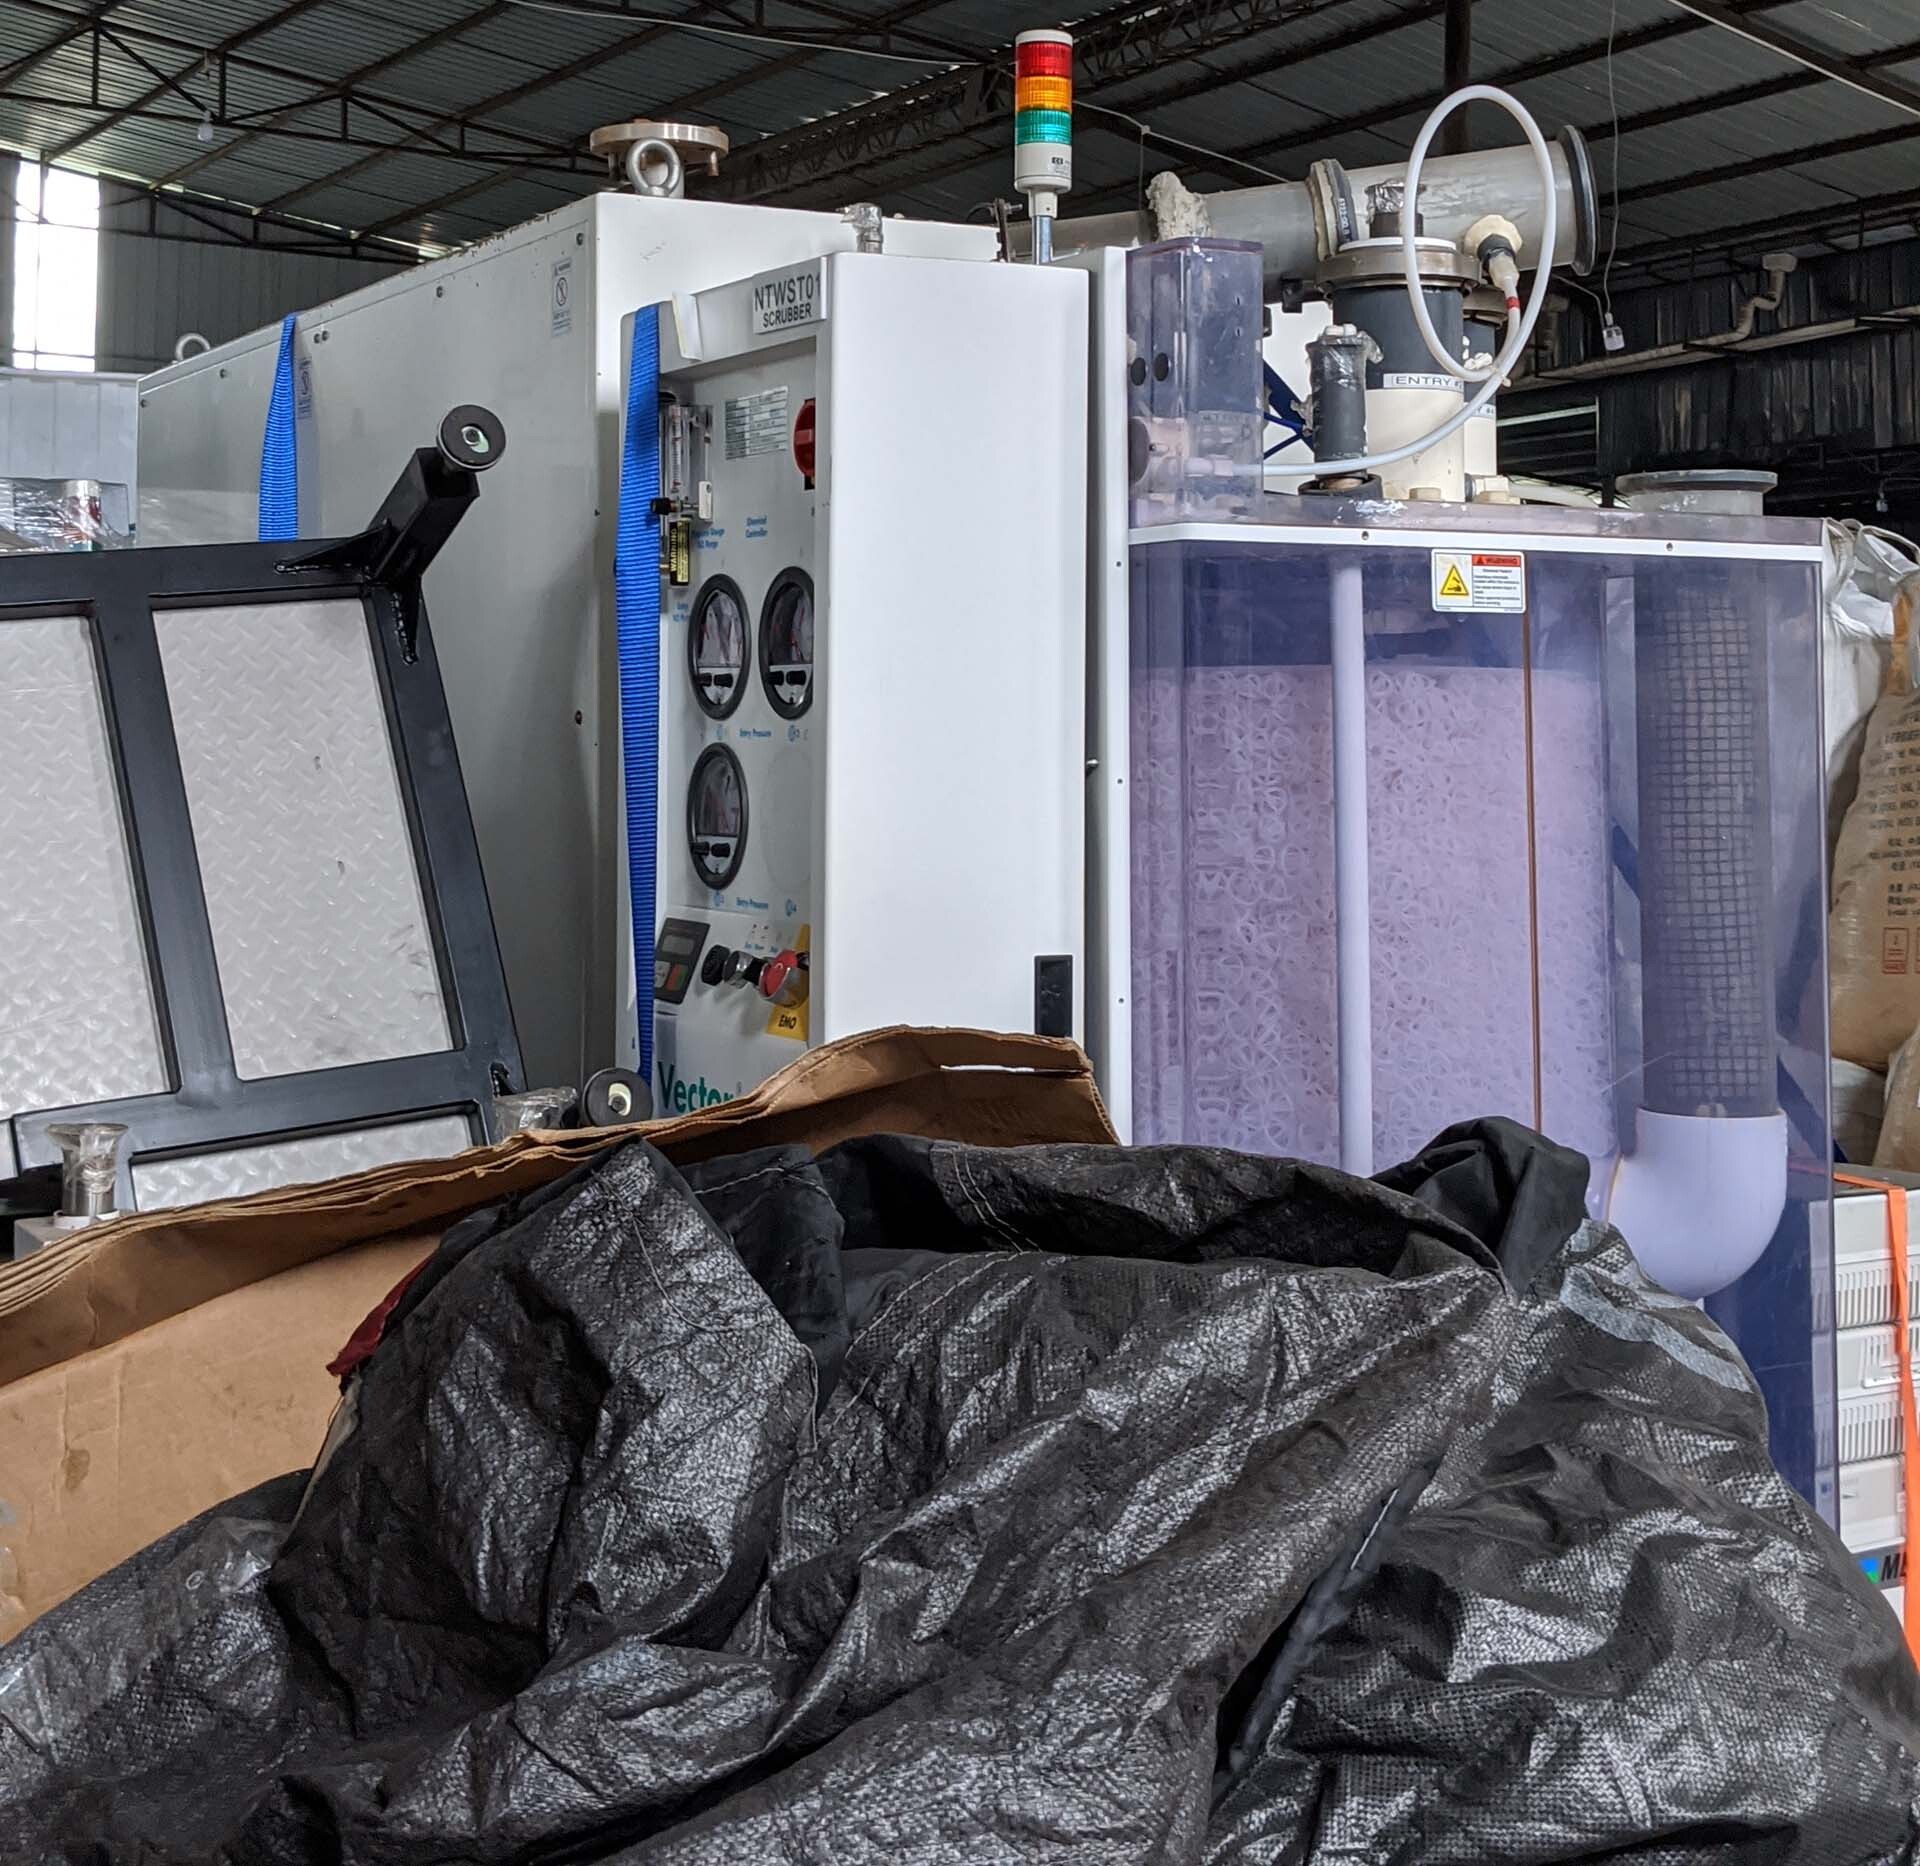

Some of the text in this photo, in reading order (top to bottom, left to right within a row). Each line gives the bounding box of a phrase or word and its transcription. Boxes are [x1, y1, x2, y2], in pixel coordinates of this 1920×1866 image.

[763, 302, 812, 328] SCRUBBER
[1396, 375, 1450, 386] ENTRY
[669, 528, 678, 572] WARNING
[778, 1014, 797, 1030] EMO
